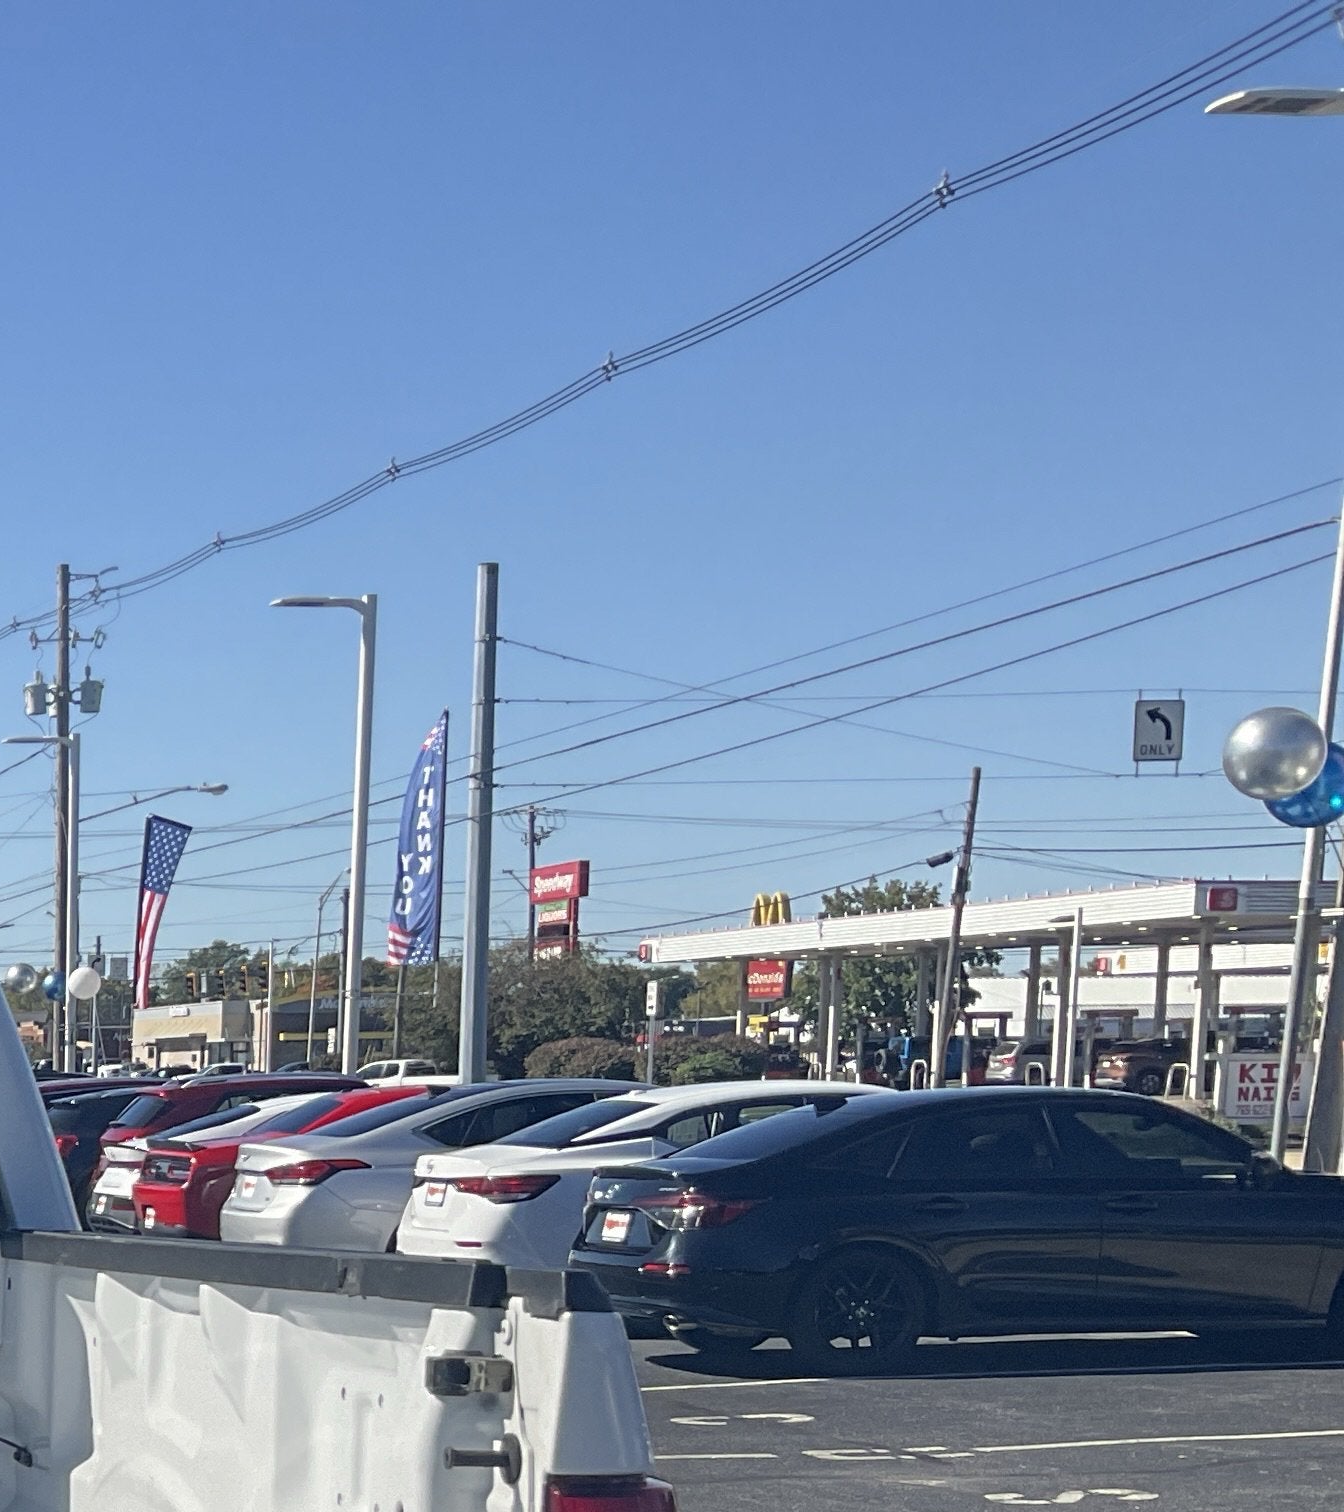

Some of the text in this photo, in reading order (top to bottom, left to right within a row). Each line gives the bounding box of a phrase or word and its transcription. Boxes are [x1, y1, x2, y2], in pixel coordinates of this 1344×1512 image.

[1139, 744, 1175, 756] ONLY
[533, 872, 574, 898] Speedway
[1237, 1086, 1300, 1102] NAIS
